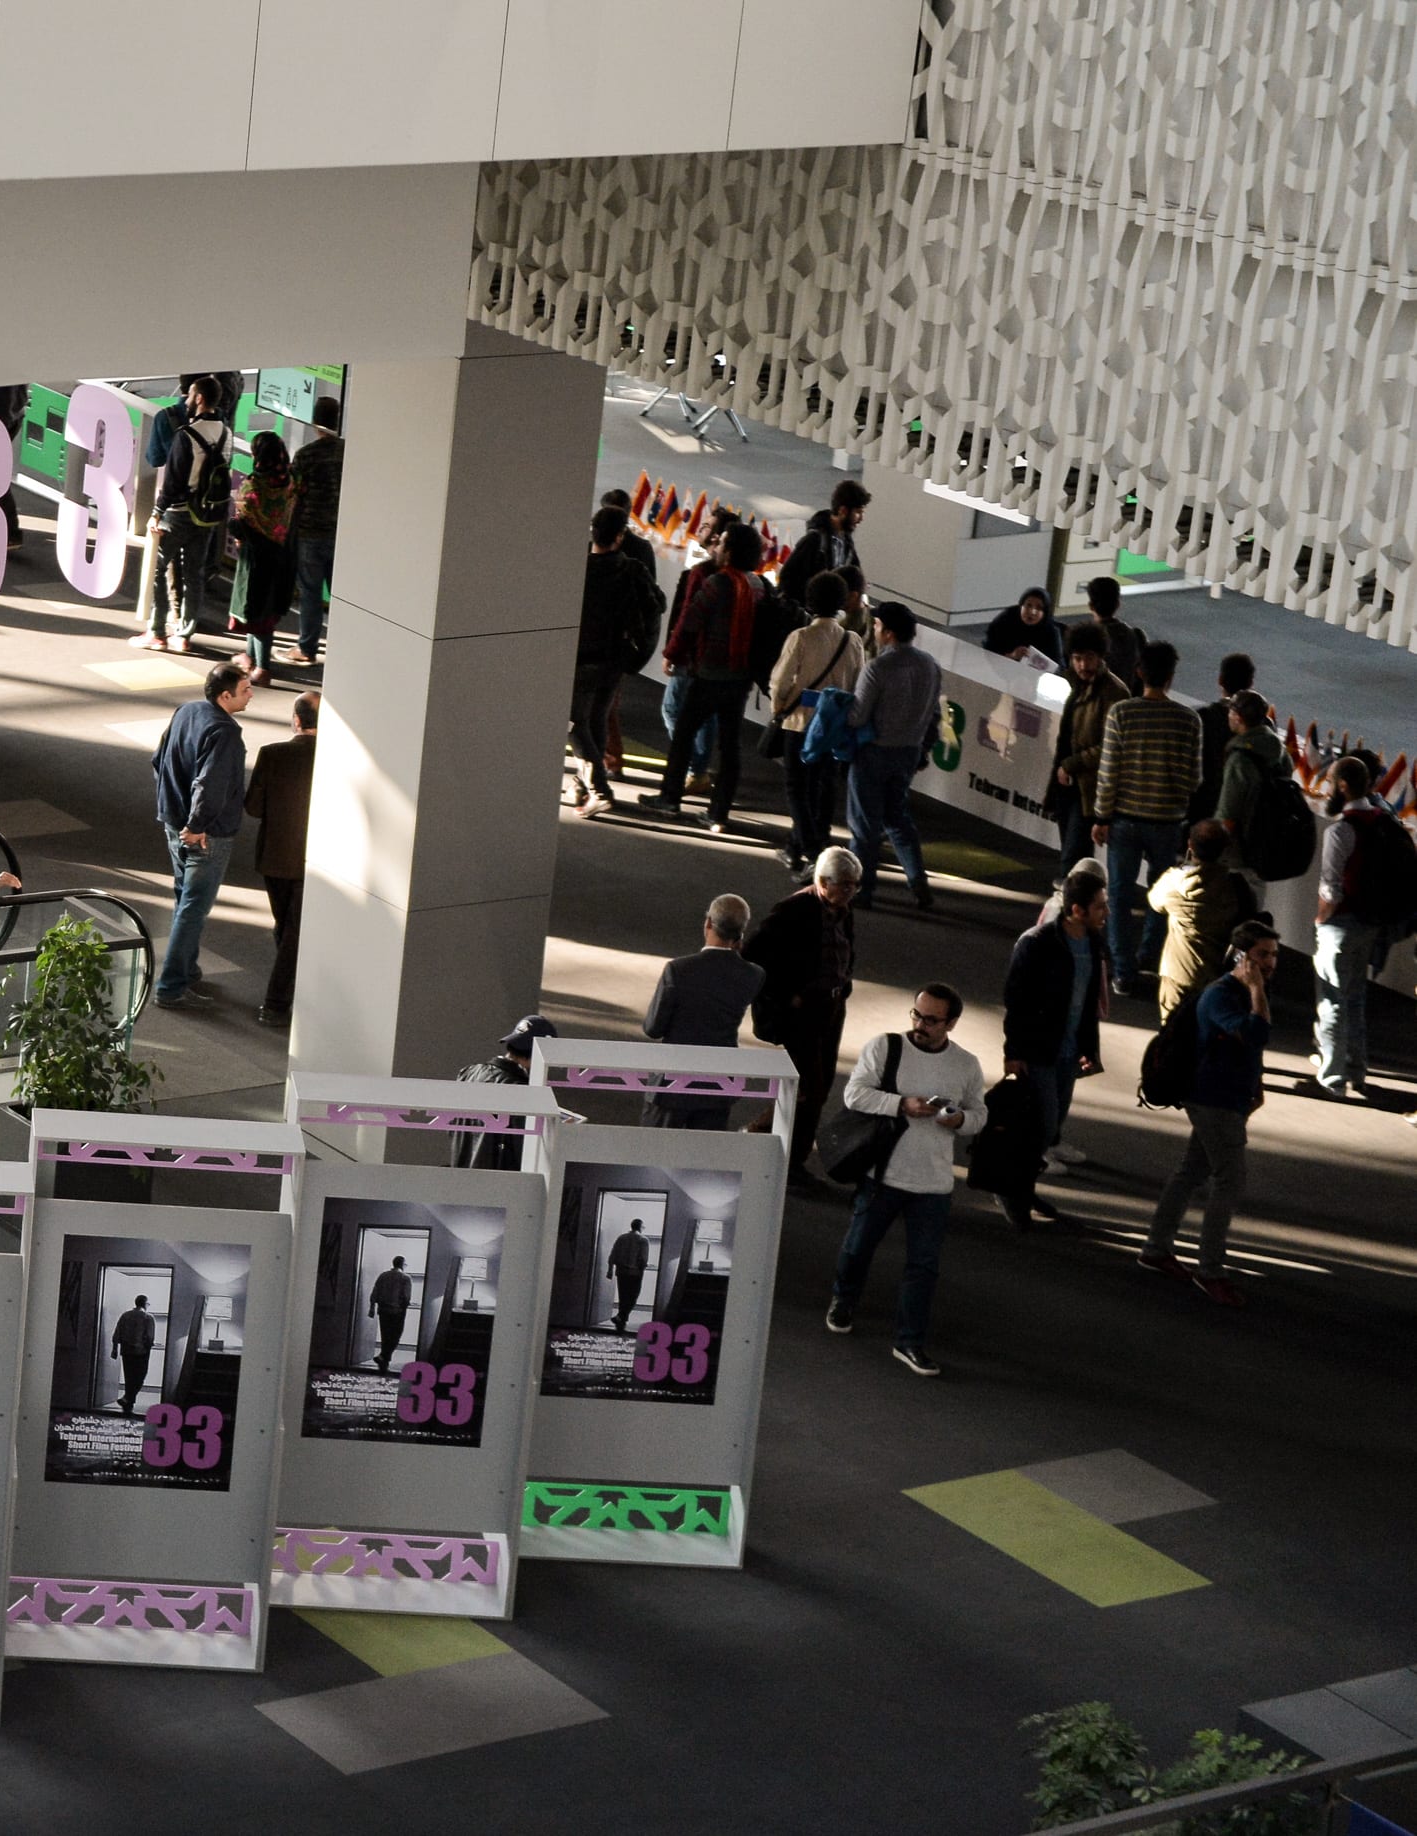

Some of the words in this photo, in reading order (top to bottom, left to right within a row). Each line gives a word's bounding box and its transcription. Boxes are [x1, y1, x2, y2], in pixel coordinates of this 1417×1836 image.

[968, 772, 1009, 803] Tehran
[634, 1322, 711, 1383] 33
[398, 1362, 477, 1424] 33
[59, 1432, 88, 1441] Tehran
[89, 1434, 143, 1444] International
[68, 1441, 91, 1450] Short
[91, 1443, 110, 1451] Film
[110, 1444, 142, 1452] Festival
[144, 1404, 224, 1469] 33
